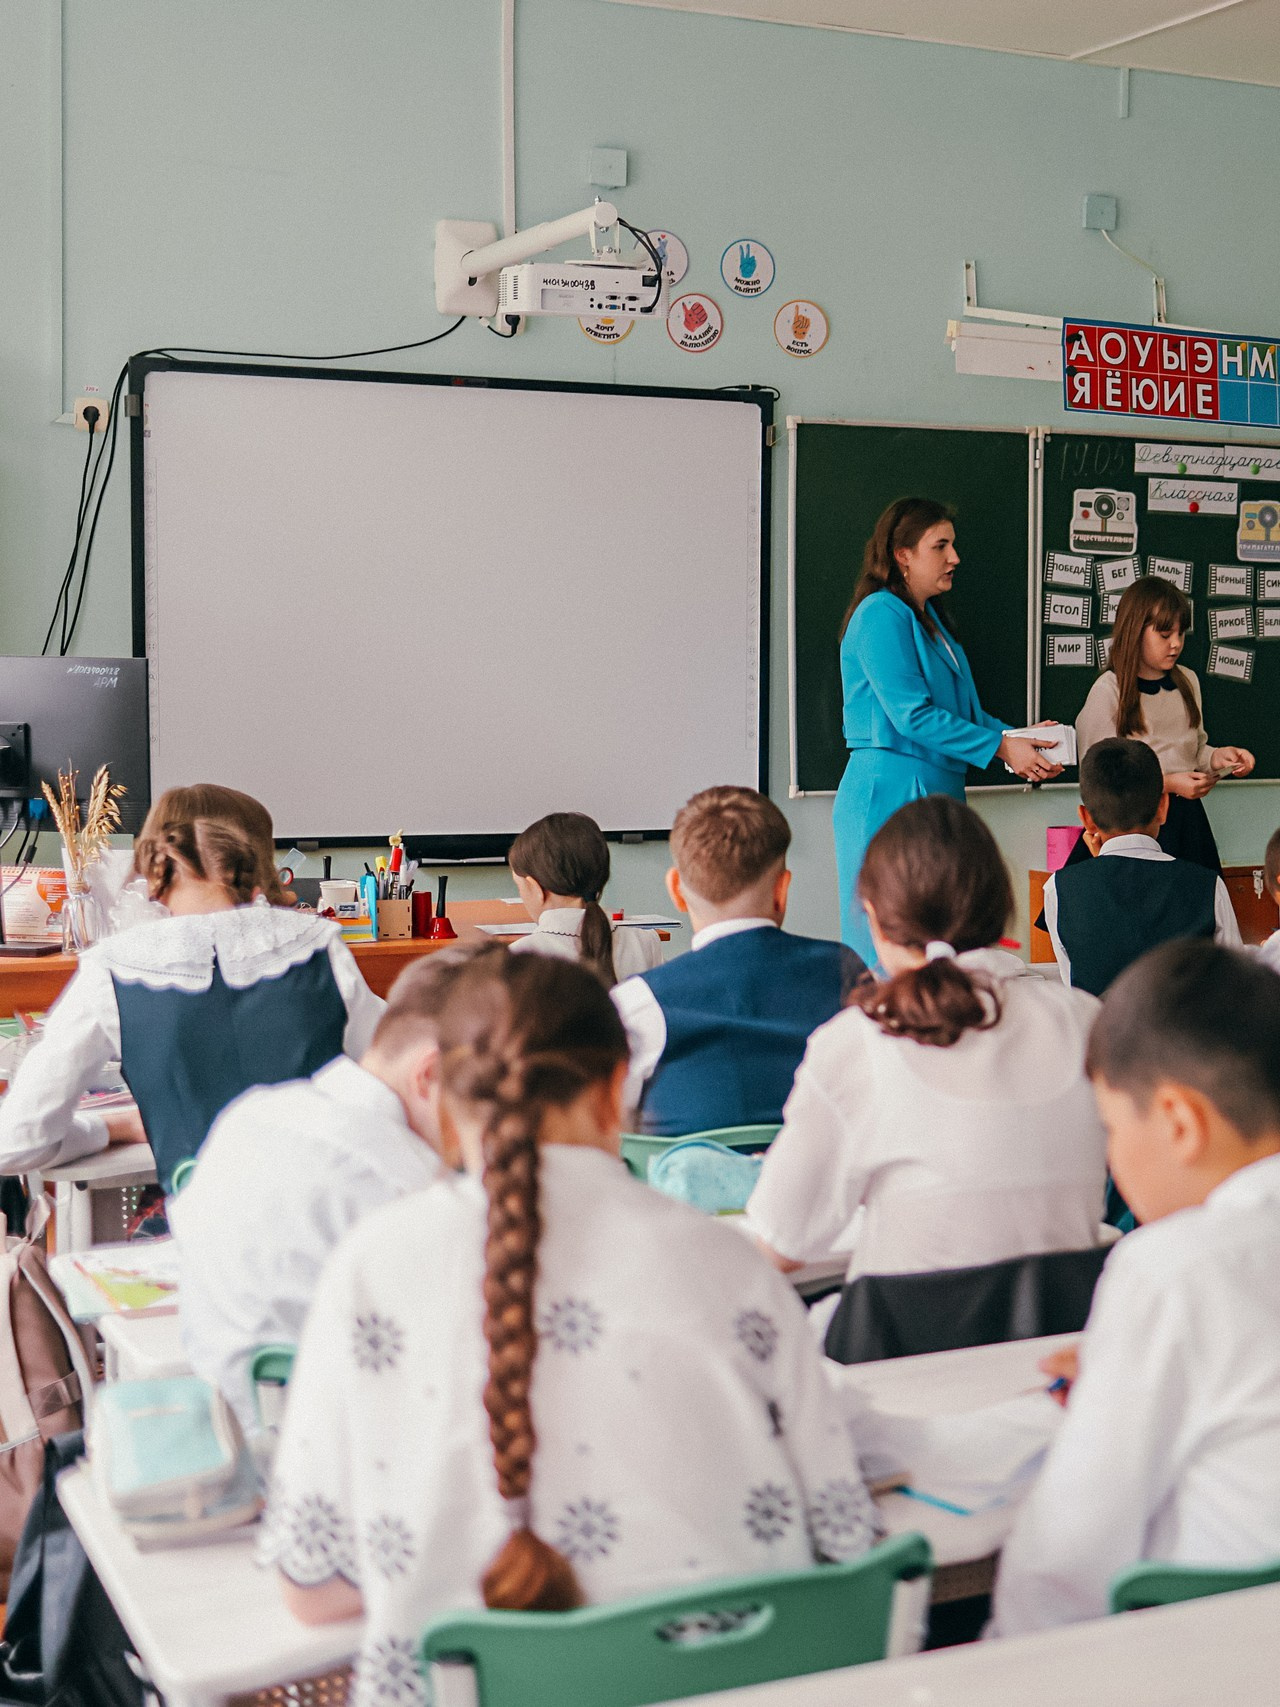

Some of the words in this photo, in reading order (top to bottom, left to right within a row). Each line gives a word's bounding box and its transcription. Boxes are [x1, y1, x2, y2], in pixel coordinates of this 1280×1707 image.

[734, 277, 760, 286] МОЖНО
[586, 327, 620, 339] ОТВЕТИТЬ
[595, 324, 615, 332] ХОЧУ
[786, 345, 812, 354] ВОПРОС
[1112, 568, 1127, 579] БЕГ
[1216, 575, 1246, 584] ЧЁРНЫЕ
[1053, 604, 1079, 615] СТОЛ
[1218, 617, 1246, 628] ЯРКОЕ
[1057, 644, 1081, 653] МИР
[1218, 656, 1245, 667] НОВАЯ
